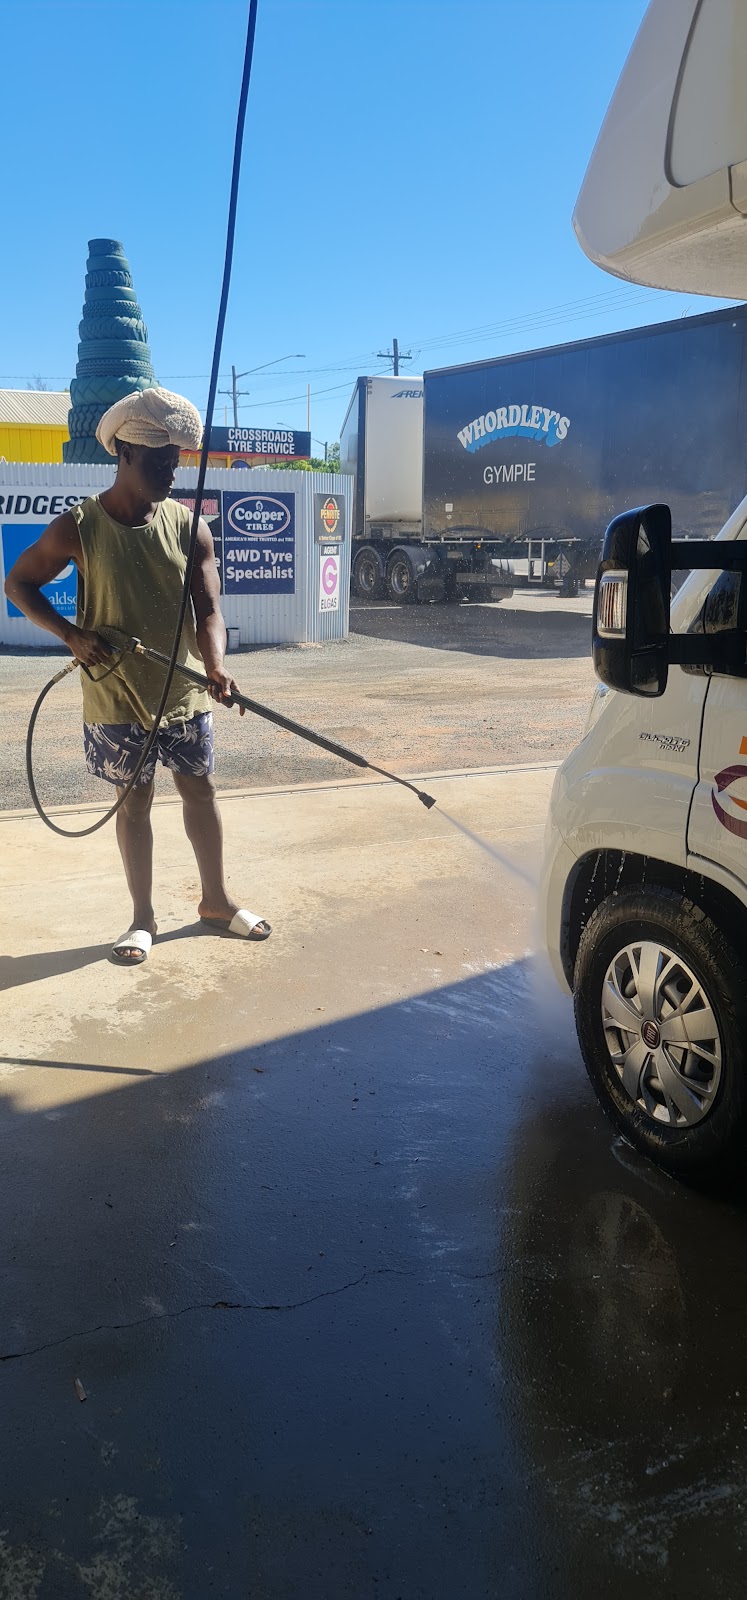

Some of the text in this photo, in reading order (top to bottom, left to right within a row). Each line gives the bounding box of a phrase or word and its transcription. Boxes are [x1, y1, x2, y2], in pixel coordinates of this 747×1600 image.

[398, 390, 424, 398] FREI
[456, 404, 571, 450] WHORDLEY'S
[228, 428, 294, 443] CROSSROADS
[227, 440, 295, 455] TYRE SERVICE
[483, 463, 536, 484] GYMPIE
[234, 507, 285, 523] Cooper
[320, 509, 340, 520] PENRITE
[245, 523, 274, 531] TIRES
[226, 549, 260, 562] 4WD
[262, 549, 293, 565] Tyre
[323, 546, 337, 555] AGENT
[226, 566, 294, 582] Specialist
[321, 598, 337, 610] ELGAS
